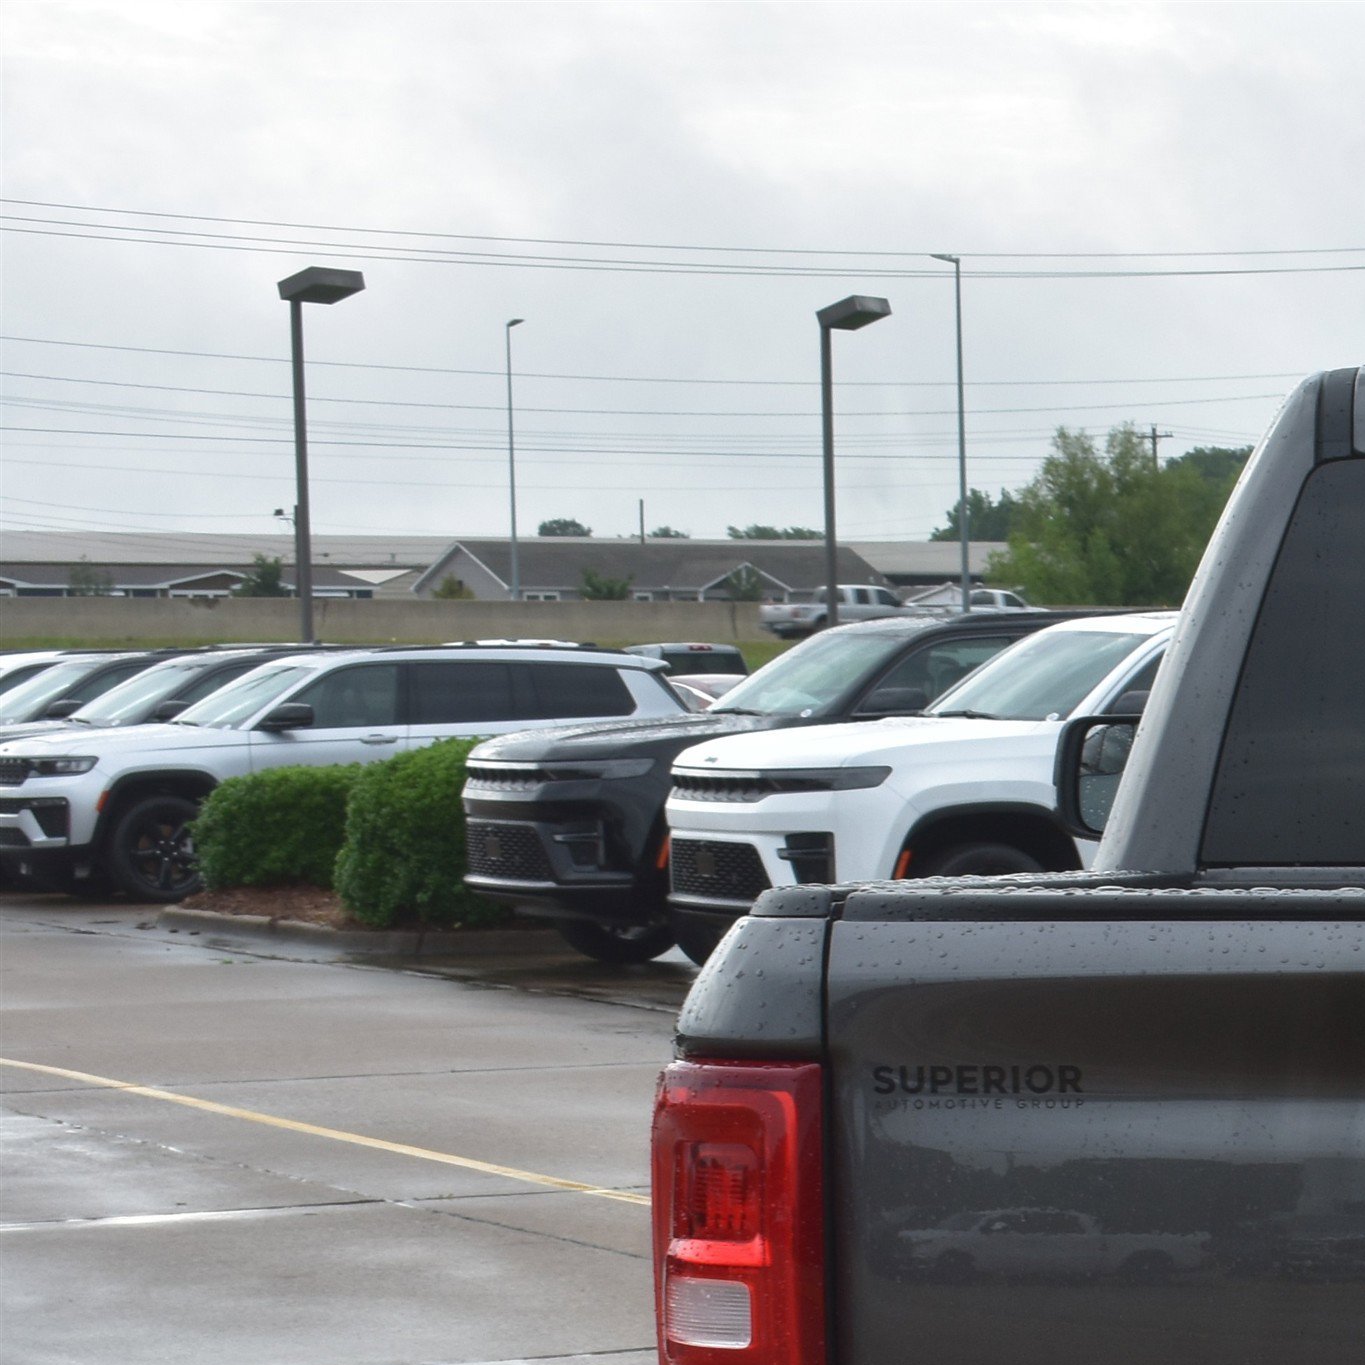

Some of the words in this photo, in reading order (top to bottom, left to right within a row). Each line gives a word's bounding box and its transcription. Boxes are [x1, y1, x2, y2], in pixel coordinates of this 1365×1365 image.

[872, 1064, 1084, 1095] SUPERIOR
[873, 1098, 1004, 1111] AUTOMOTIVE
[1015, 1098, 1086, 1110] GROUP
